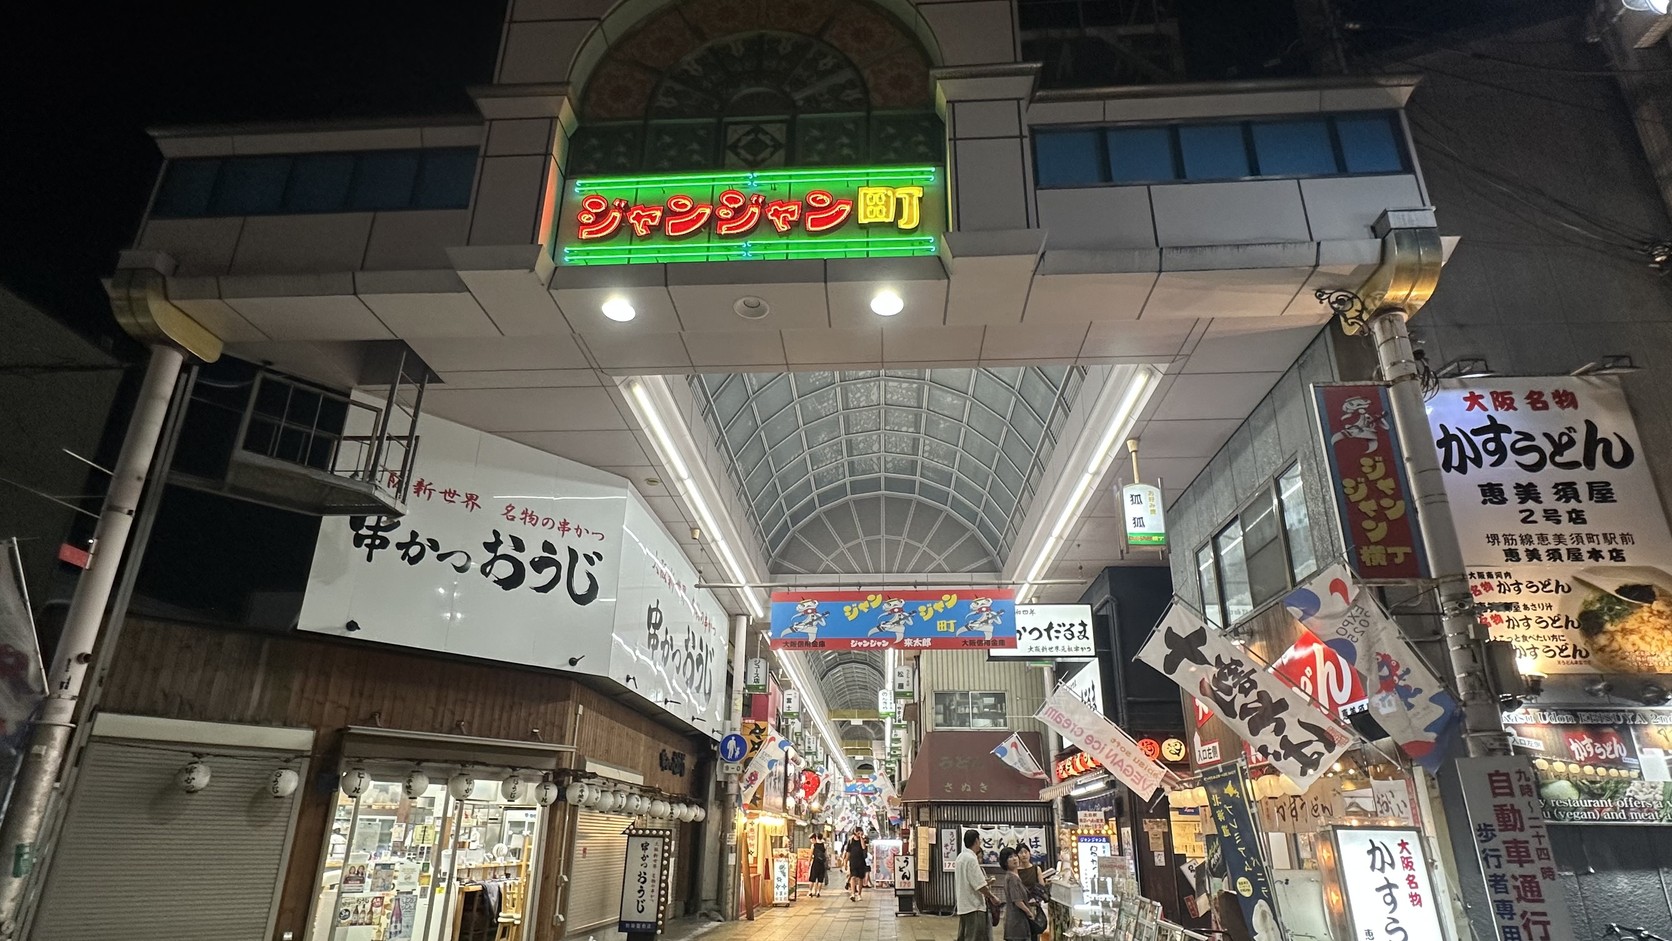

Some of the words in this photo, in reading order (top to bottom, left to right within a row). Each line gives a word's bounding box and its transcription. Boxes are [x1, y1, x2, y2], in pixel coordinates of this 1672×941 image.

[577, 186, 924, 239] ジャンジャン町
[1463, 390, 1579, 412] 大阪名物
[1436, 415, 1635, 475] かすうどん
[1478, 481, 1617, 505] 恵美須屋
[500, 503, 606, 541] 名物の串かつ
[1486, 533, 1636, 547] 堺筋線恵美須町駅前
[349, 515, 603, 606] 串かつおうじ
[1359, 545, 1412, 566] 横丁
[1503, 548, 1627, 563] 恵美須屋本店
[1471, 581, 1494, 596] 名物
[1497, 579, 1572, 596] かすうどん
[843, 593, 883, 622] ジャン
[918, 593, 958, 620] ジャン
[936, 620, 957, 633] 町
[1016, 619, 1090, 641] かつだるま
[1505, 613, 1582, 630] かすうどん
[647, 598, 715, 705] 串かつおうじ
[850, 639, 889, 647] ジャンジャン
[1538, 712, 1576, 724] Udon
[1198, 745, 1219, 762] 入口左側
[1568, 734, 1627, 761] かすうどん
[944, 782, 988, 793] さぬき
[1551, 797, 1613, 808] restaurant
[1617, 797, 1653, 808] offers
[1554, 809, 1600, 820] (vegan)
[1603, 809, 1626, 819] and
[1630, 810, 1662, 819] meat
[1488, 769, 1551, 941] 自動車通行
[636, 841, 650, 914] 串かつおうじ
[898, 857, 911, 880] うどん
[1397, 838, 1422, 908] 大阪名物
[1477, 823, 1522, 941] 歩行者専用
